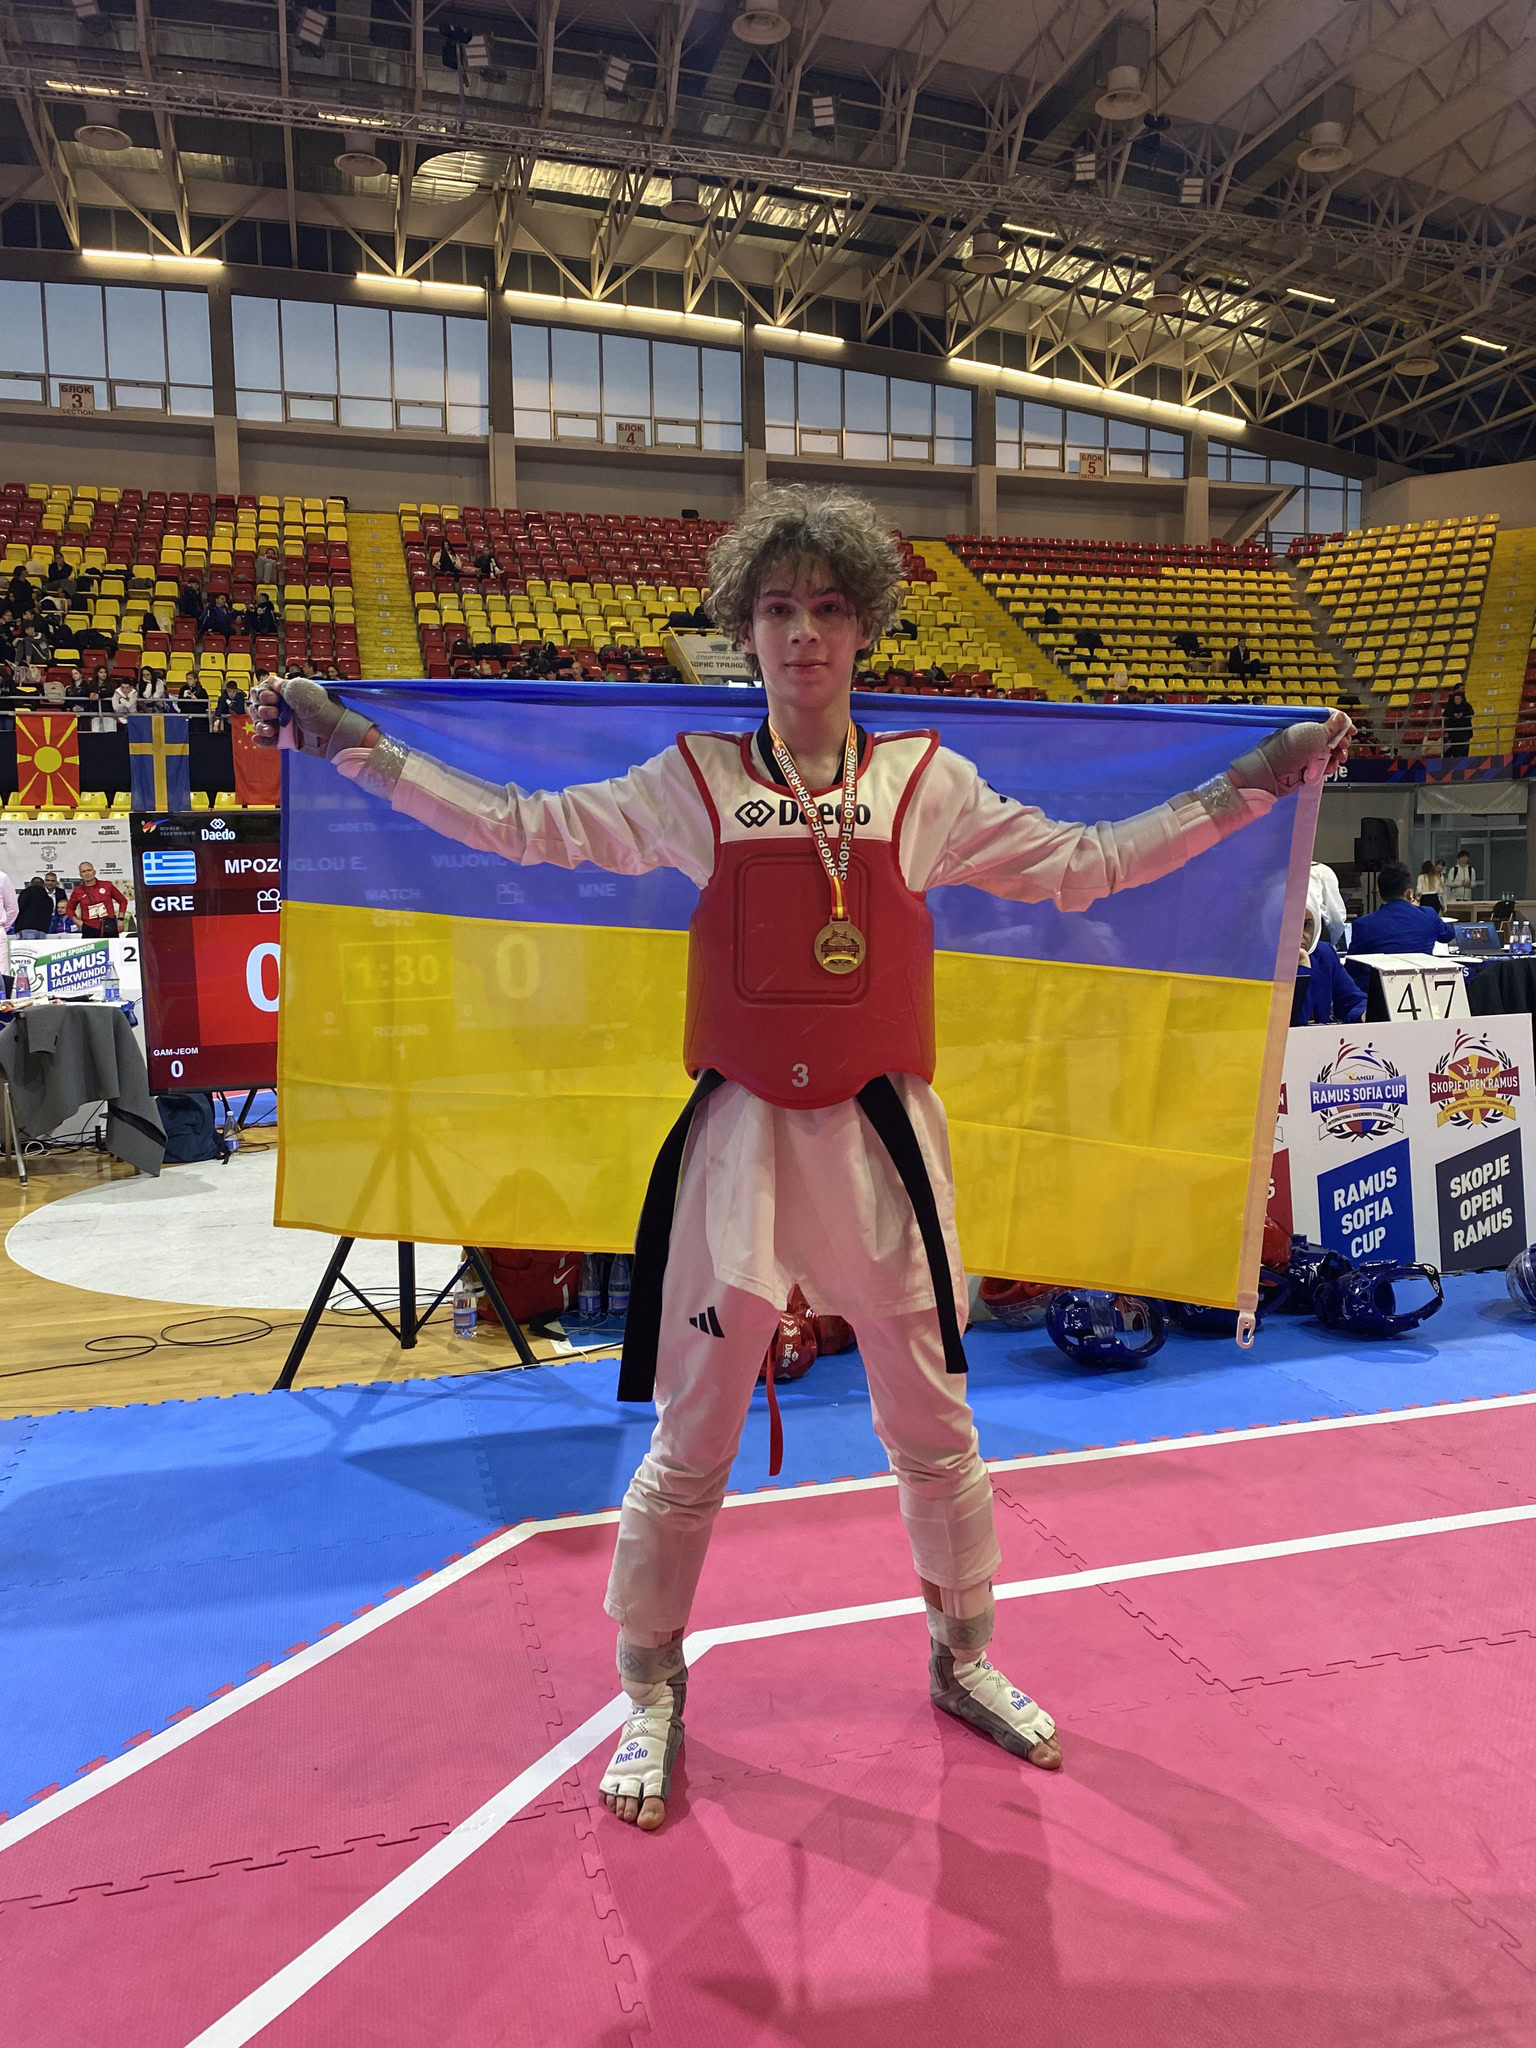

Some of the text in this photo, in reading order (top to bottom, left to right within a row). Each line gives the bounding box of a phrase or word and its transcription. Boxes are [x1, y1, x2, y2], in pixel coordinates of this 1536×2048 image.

[61, 385, 91, 394] БЛОК
[72, 394, 83, 409] 3
[618, 424, 643, 432] БЛОК
[626, 432, 635, 445] 4
[1088, 462, 1096, 474] 5
[776, 748, 802, 785] RAMUS
[846, 747, 856, 784] RAMUS
[796, 786, 818, 818] OPEN
[843, 786, 856, 818] OPEN
[18, 828, 77, 836] СМДЛ РАМУС
[201, 828, 236, 840] Daedo
[151, 896, 194, 912] GRE
[51, 952, 67, 960] MAIN
[68, 943, 96, 957] SPONSOR
[124, 946, 137, 962] 2
[51, 950, 106, 978] RAMUS
[496, 933, 541, 999] 0
[51, 966, 106, 988] TAEKWONDO
[246, 942, 284, 1012] 0
[153, 1047, 198, 1056] GAM-JEOM
[170, 1060, 184, 1078] 0
[791, 1063, 809, 1087] 3
[1312, 1084, 1405, 1104] RAMUS SOFIA CUP
[1431, 1075, 1518, 1094] SKOPJE OPEN RAMUS
[1449, 1154, 1511, 1199] SKOPJE
[1333, 1166, 1398, 1211] RAMUS
[1459, 1184, 1504, 1221] OPEN
[1341, 1196, 1394, 1235] SOFIA
[1453, 1207, 1514, 1252] RAMUS
[1351, 1226, 1387, 1258] CUP
